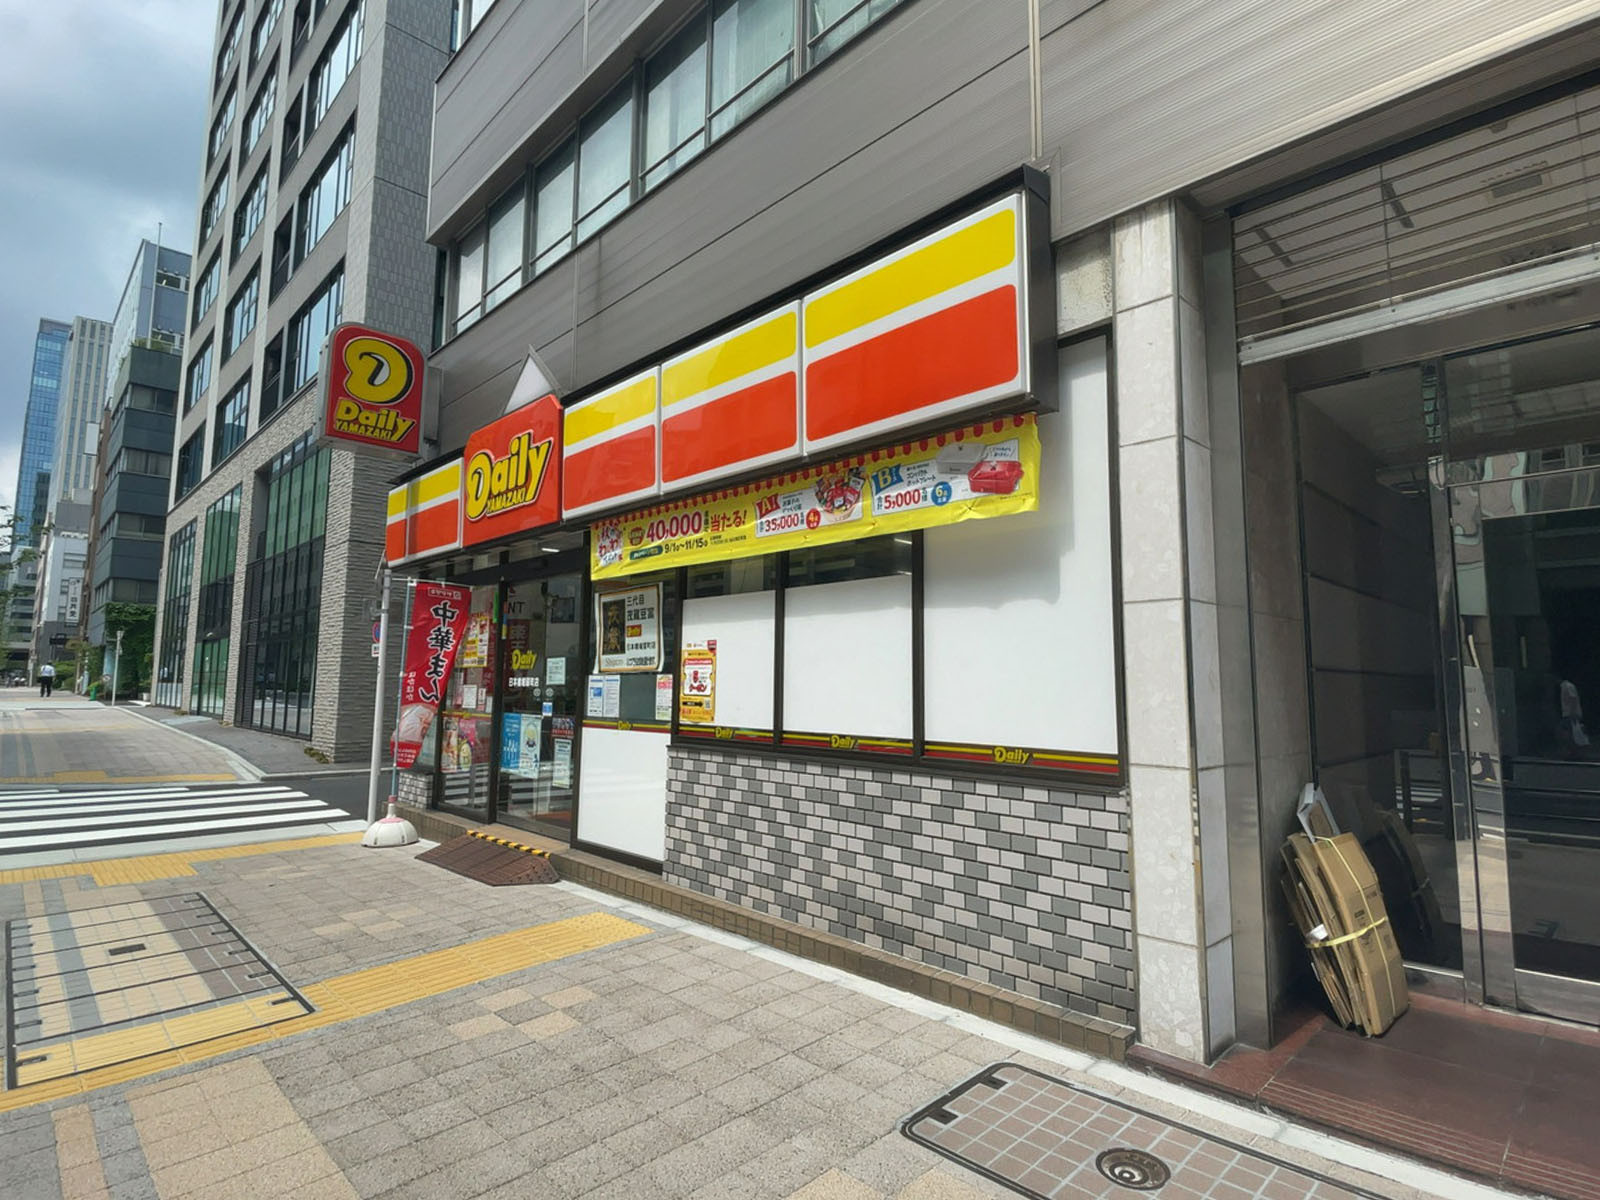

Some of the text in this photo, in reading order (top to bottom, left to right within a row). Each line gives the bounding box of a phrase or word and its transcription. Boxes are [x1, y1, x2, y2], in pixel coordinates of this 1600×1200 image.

[336, 398, 415, 441] Daily
[336, 419, 392, 439] YAMAZAKI
[466, 432, 552, 518] Daily
[487, 487, 526, 513] YAMAZAKI
[884, 489, 921, 509] 5,000
[646, 512, 702, 542] 40,000
[765, 513, 799, 532] 35,000
[627, 594, 645, 606] 三代目
[512, 649, 537, 670] Daily
[716, 726, 733, 739] Daily
[831, 734, 855, 749] Daily
[994, 746, 1029, 764] Daily
